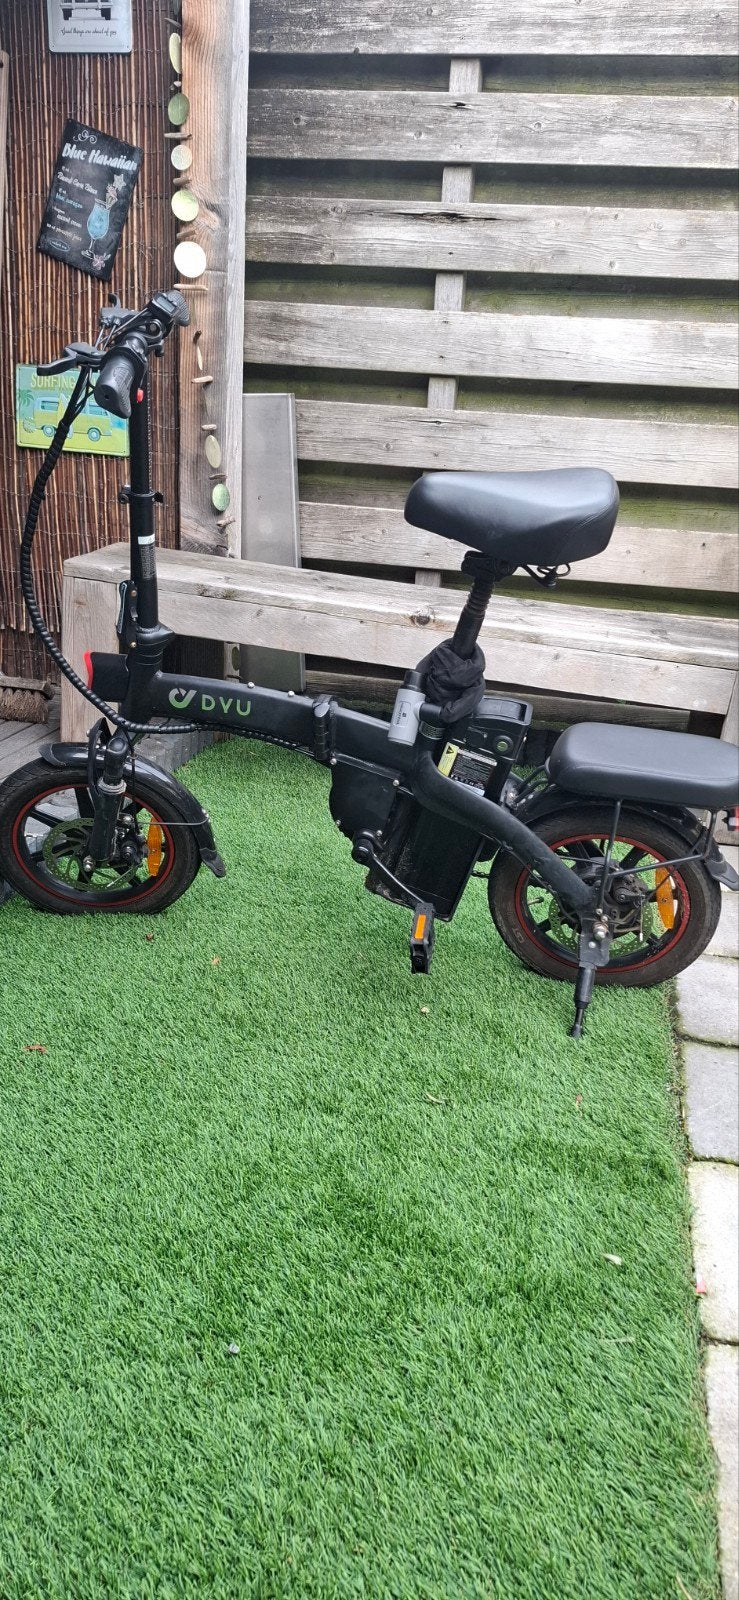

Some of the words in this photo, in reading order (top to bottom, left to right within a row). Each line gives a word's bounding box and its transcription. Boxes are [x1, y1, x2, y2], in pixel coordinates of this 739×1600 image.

[62, 142, 87, 160] Blue
[88, 149, 138, 171] Hawaiian
[31, 371, 76, 389] SURFING
